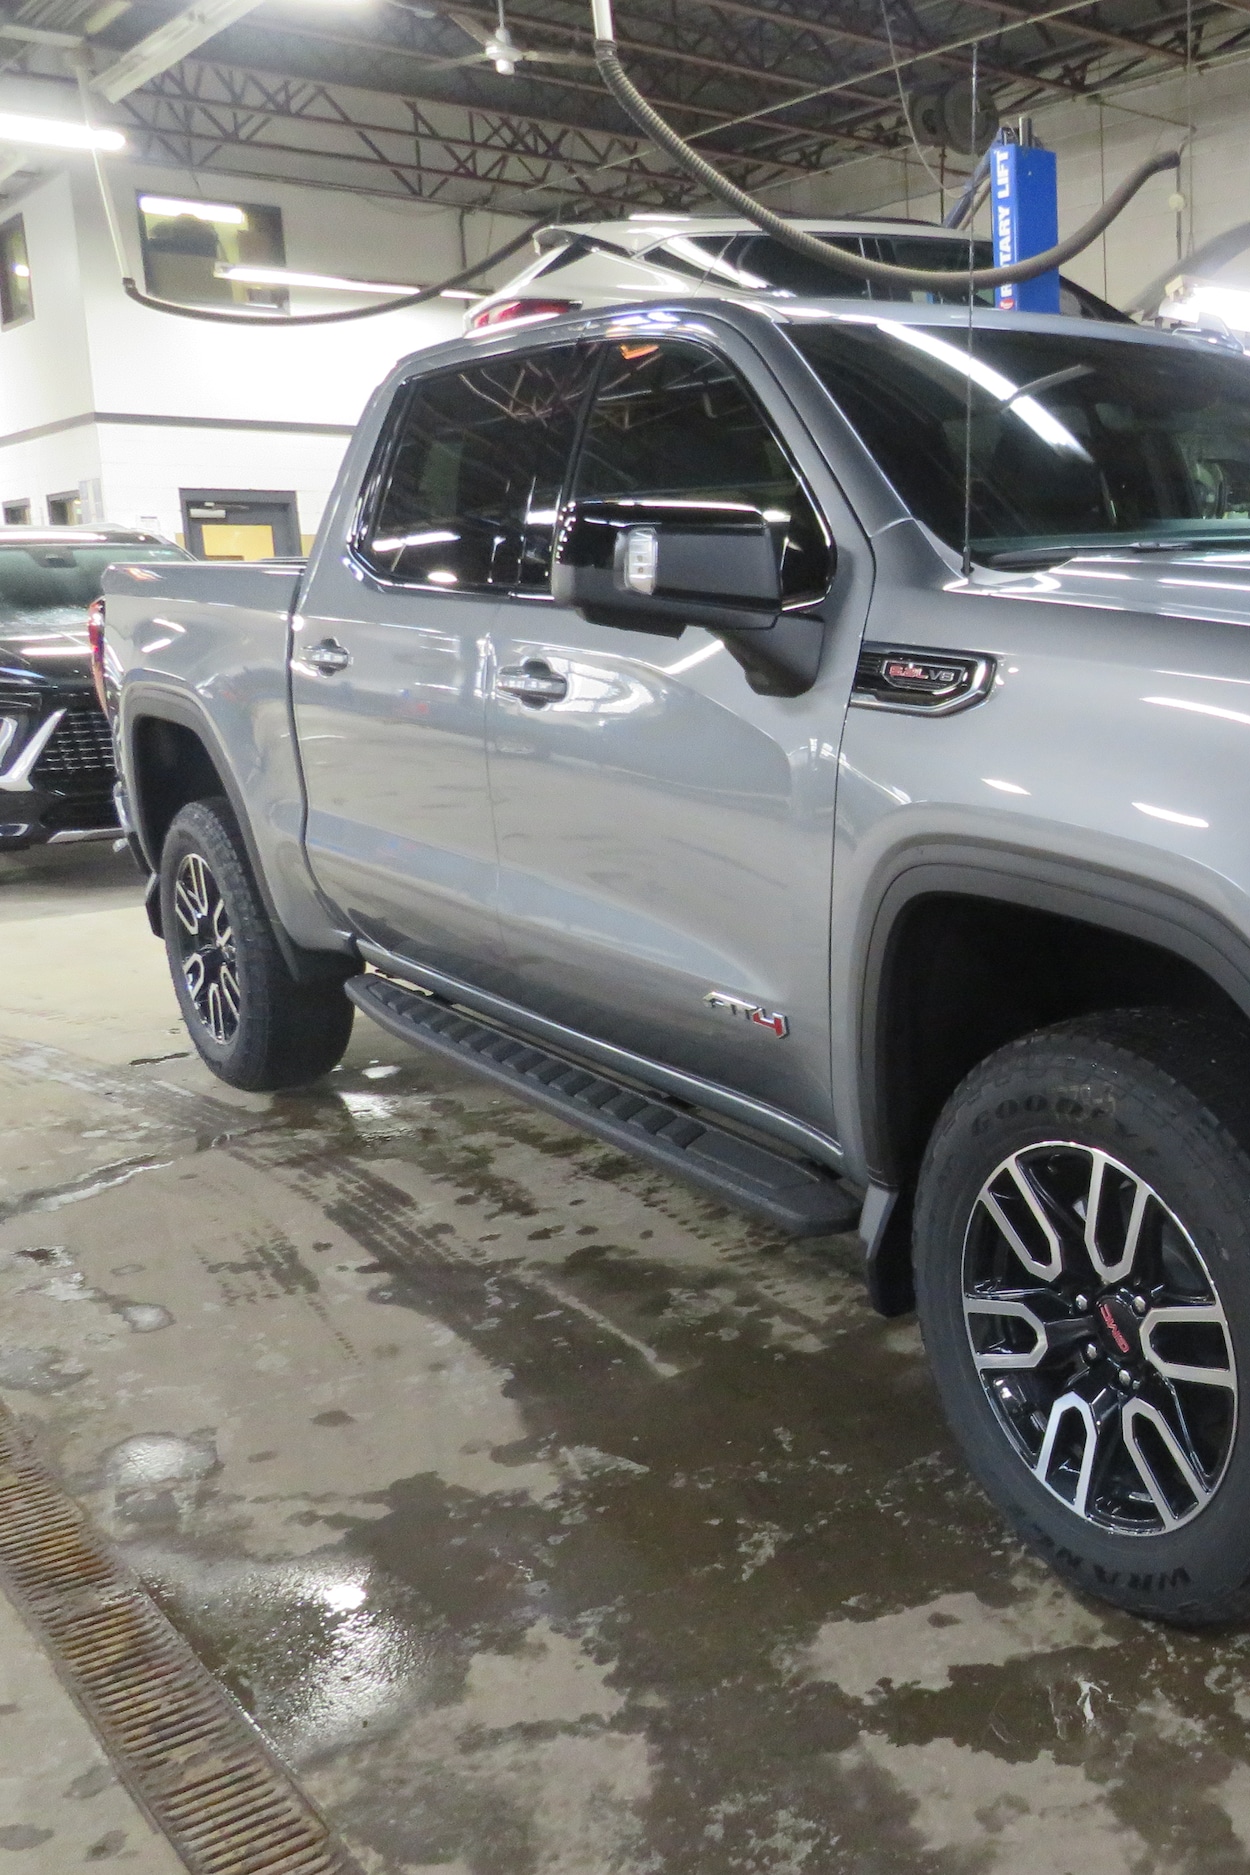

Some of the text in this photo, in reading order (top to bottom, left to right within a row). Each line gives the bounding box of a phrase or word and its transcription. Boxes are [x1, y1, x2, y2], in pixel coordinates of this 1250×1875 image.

[994, 149, 1010, 199] LIFT
[998, 205, 1013, 297] RTARY
[929, 669, 955, 682] V8
[1100, 1303, 1130, 1353] GMC
